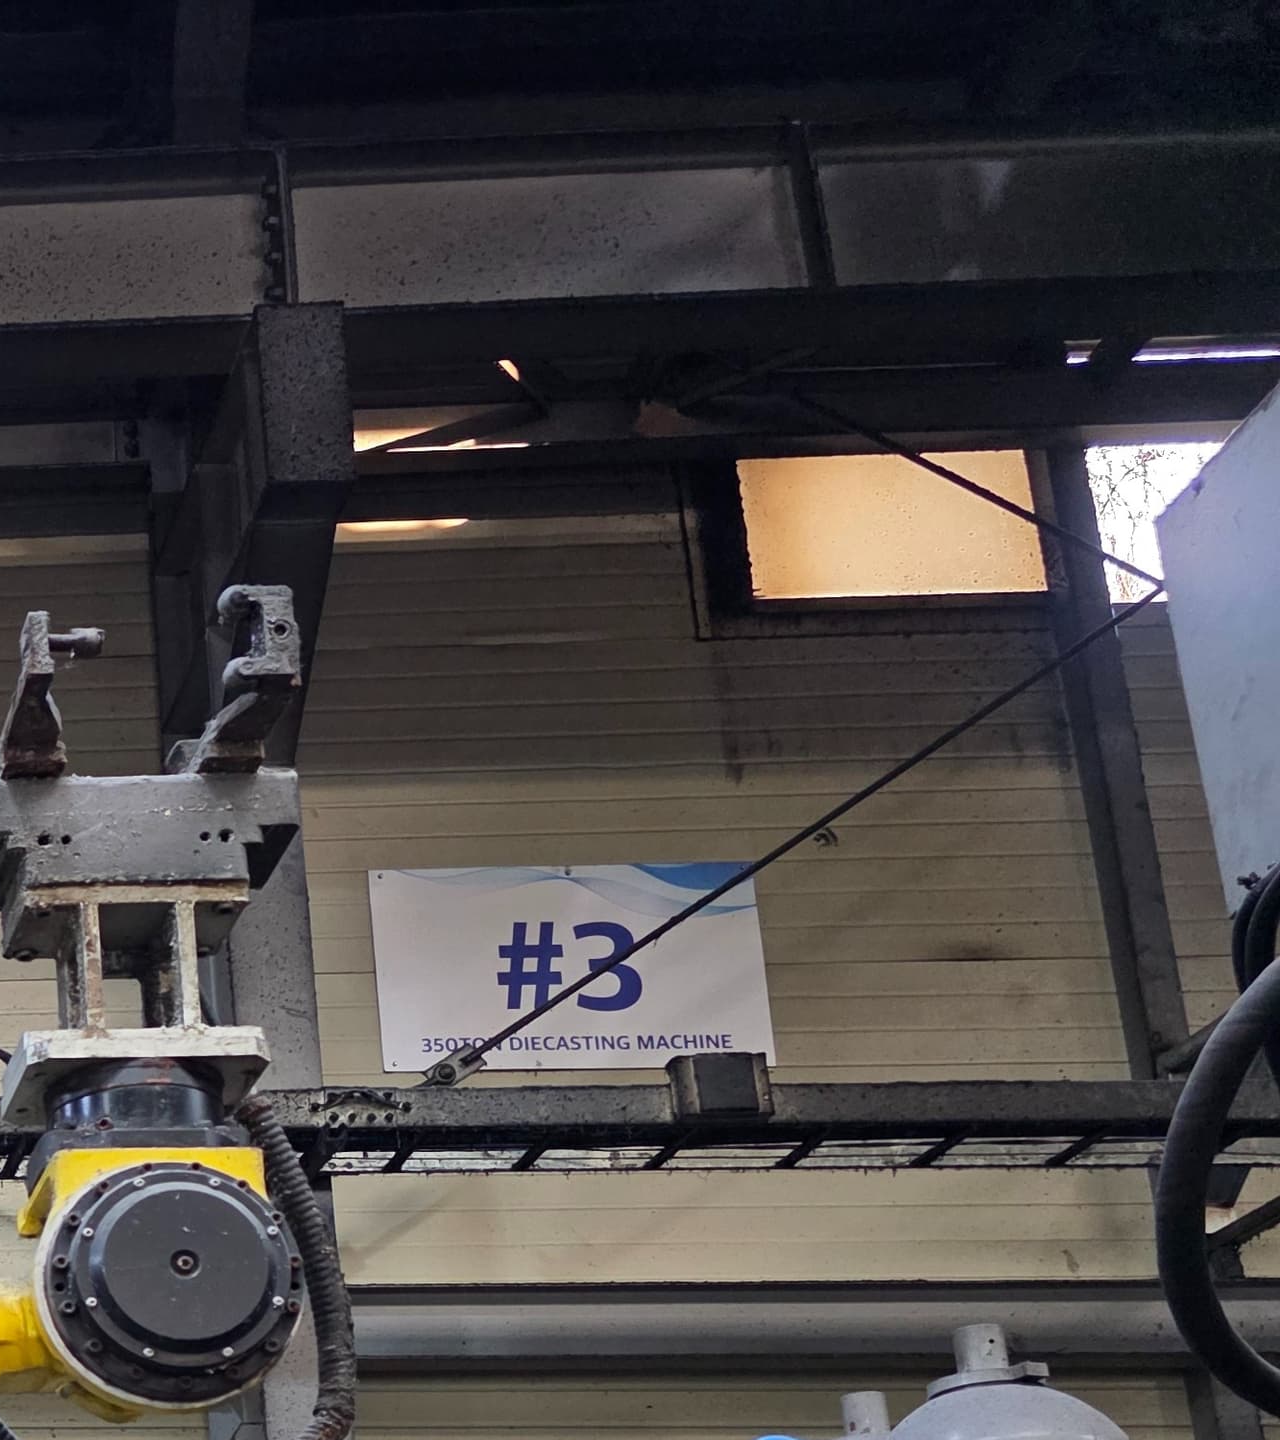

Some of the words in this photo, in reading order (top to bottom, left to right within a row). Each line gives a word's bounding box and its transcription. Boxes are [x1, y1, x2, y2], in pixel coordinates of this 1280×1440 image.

[497, 921, 643, 1011] #3
[509, 1034, 630, 1051] DIECASTING
[637, 1034, 733, 1050] MACHINE
